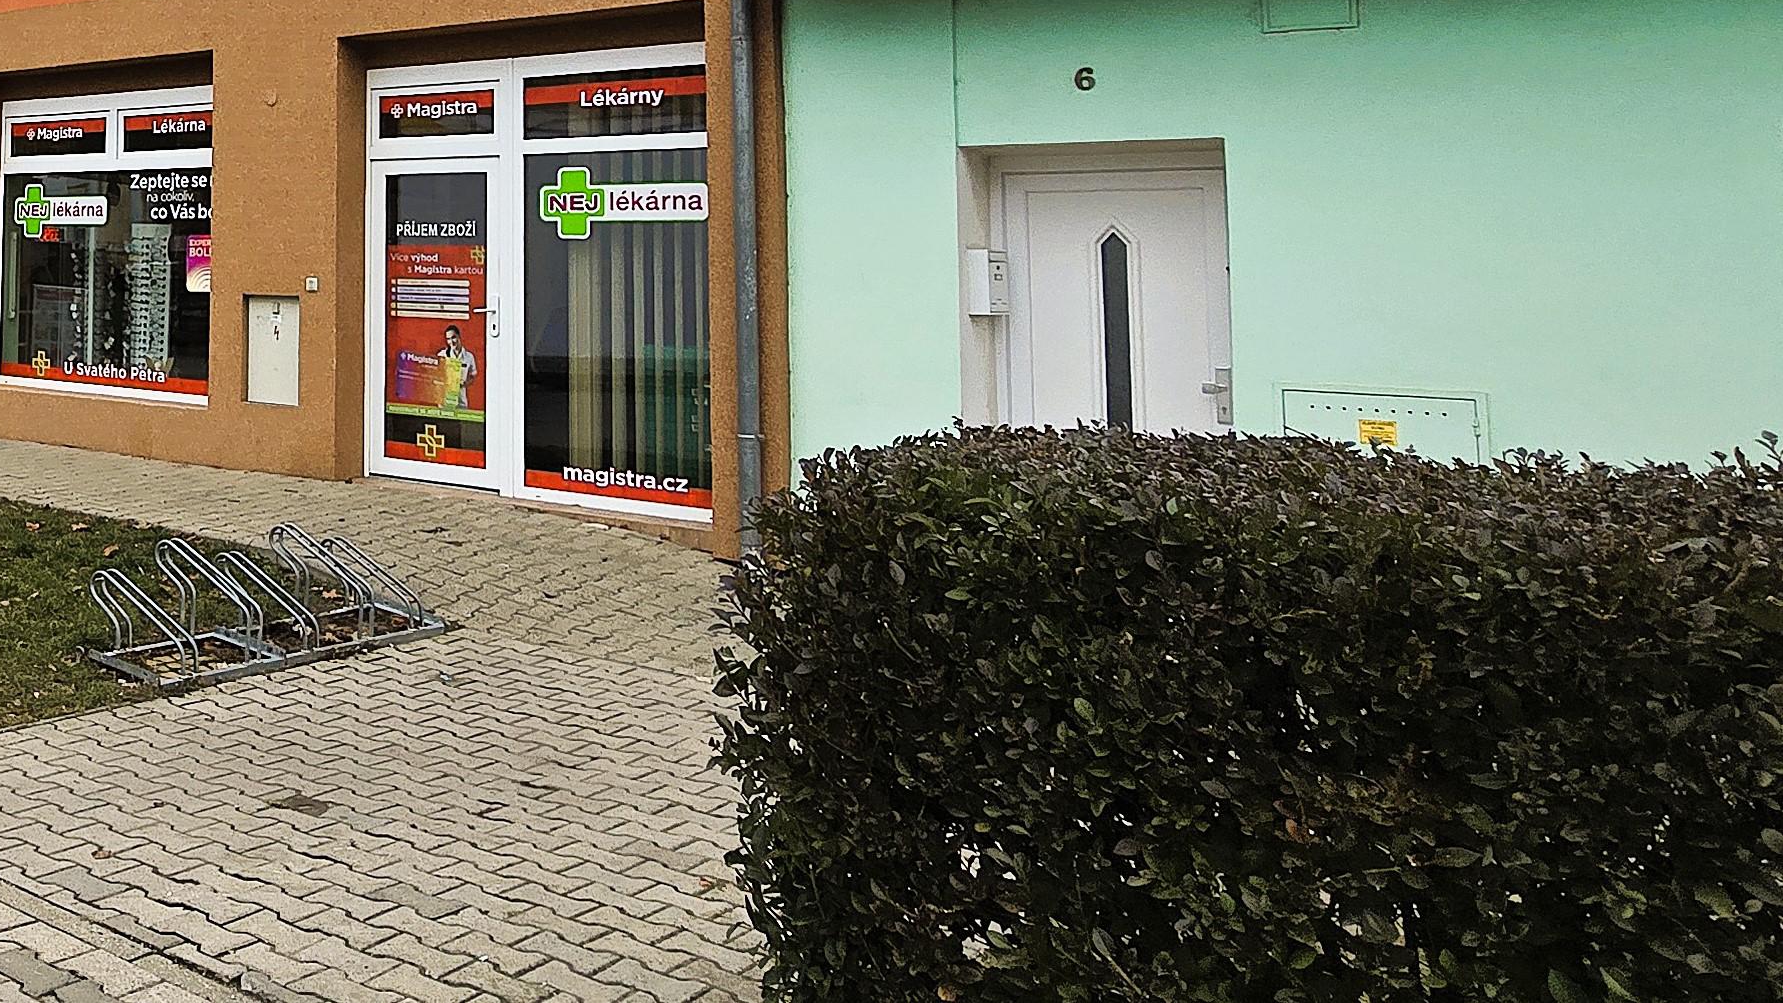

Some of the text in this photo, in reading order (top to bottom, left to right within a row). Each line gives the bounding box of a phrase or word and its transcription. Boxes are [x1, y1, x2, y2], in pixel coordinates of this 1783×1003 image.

[1074, 66, 1096, 91] 6
[579, 87, 664, 110] Lékárny
[406, 100, 478, 121] Magistra
[37, 126, 83, 142] Magistra
[153, 117, 206, 134] Lékárna
[129, 171, 190, 192] Zeptejte
[191, 174, 208, 188] se
[146, 193, 159, 203] na
[549, 189, 703, 212] NEJ lékárna
[19, 200, 104, 218] NEJ lékárna
[150, 206, 168, 219] co
[169, 202, 196, 219] Vás
[396, 220, 476, 237] PŘÍJEM ZBOŽÍ
[390, 252, 439, 263] Více výhod
[414, 265, 452, 275] Magistra
[454, 266, 484, 275] kartou
[64, 361, 166, 383] U Svatého Petra
[562, 465, 689, 493] magistra.cz
